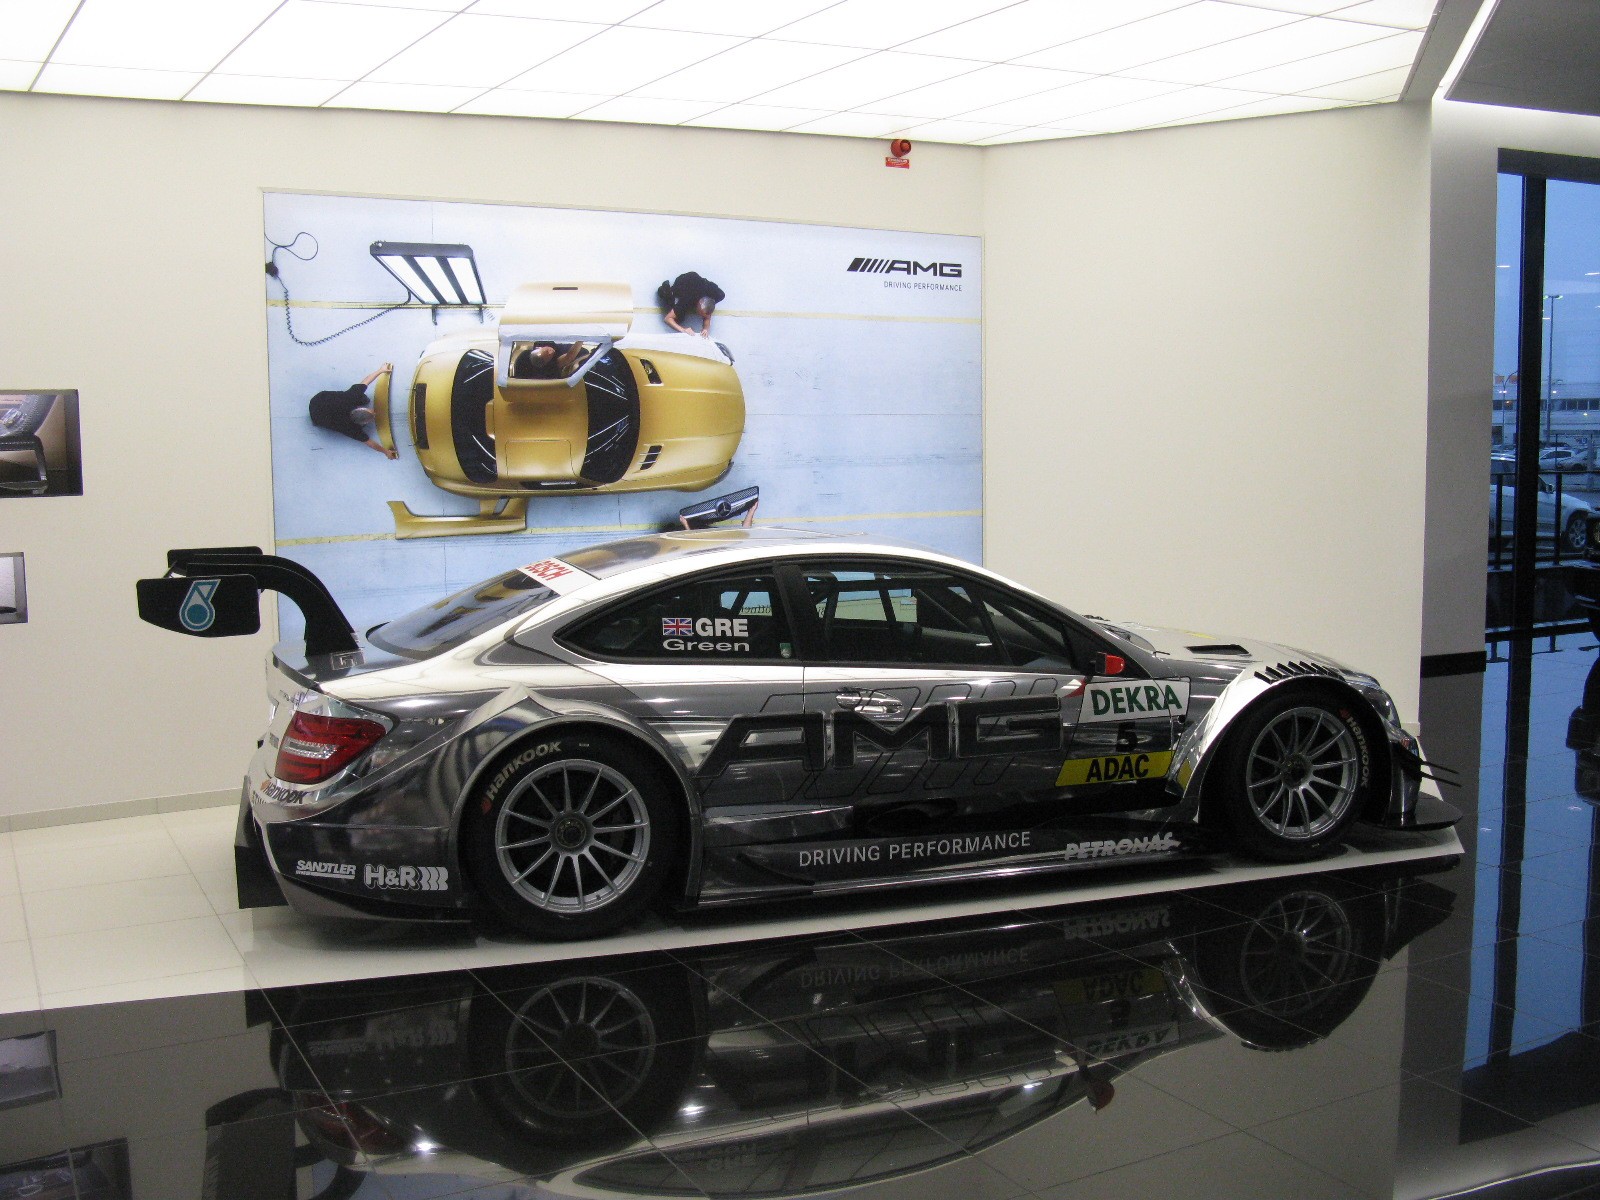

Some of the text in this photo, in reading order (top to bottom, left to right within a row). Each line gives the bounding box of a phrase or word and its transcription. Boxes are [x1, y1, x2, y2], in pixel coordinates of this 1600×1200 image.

[885, 260, 962, 278] AMG
[883, 281, 962, 292] DRIVING PERFORMANCE
[695, 617, 749, 638] GRE
[662, 638, 750, 652] Green
[1090, 684, 1183, 716] DEKRA
[696, 694, 1064, 778] AMG
[1085, 753, 1150, 783] ADAC
[799, 831, 1032, 868] DRIVING PERFORMANCE
[1063, 831, 1181, 861] PETRONAS
[296, 859, 357, 876] SANDTLER
